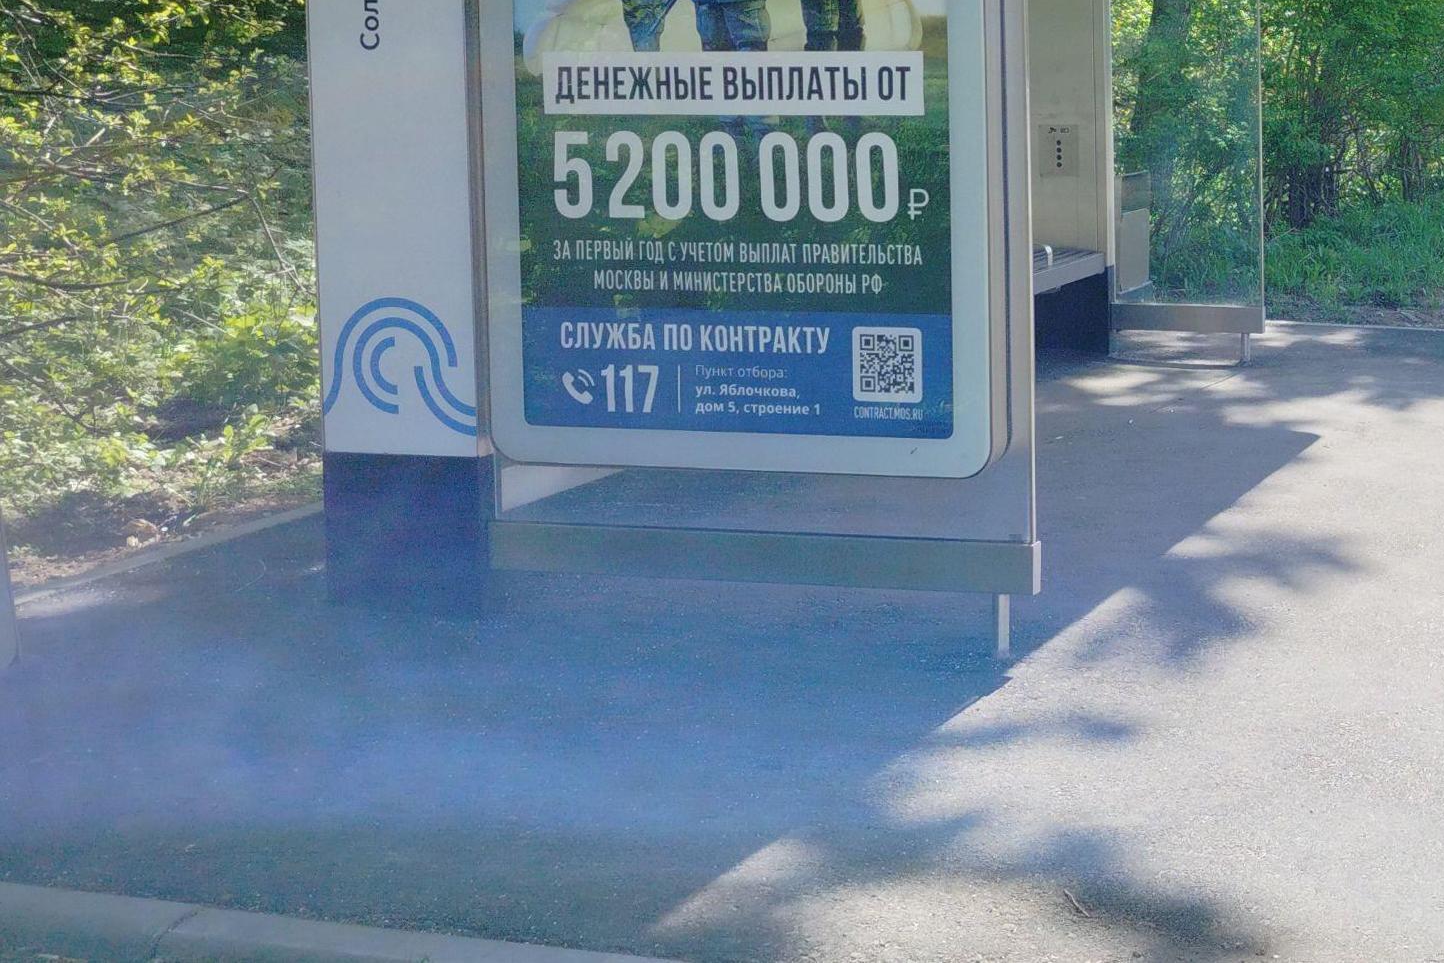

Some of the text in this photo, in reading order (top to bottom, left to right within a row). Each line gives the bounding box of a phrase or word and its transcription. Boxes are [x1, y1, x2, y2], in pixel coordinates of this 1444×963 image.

[555, 66, 911, 104] ДЕНЕЖНЫЕ ВЫПЛАТЫ ОТ
[759, 132, 899, 223] 000
[553, 237, 923, 266] ЗА ПЕРВЫЙ ГОД С УЧЕТОМ ВЫПЛАТ ПРАВИТЕЛЬСТВА
[594, 269, 883, 295] МОСКВЫ И МИНИСТЕРСТВА ОБОРОНЫ РФ
[560, 321, 830, 354] СЛУЖБА ПО КОНТРАКТУ
[695, 364, 788, 380] Пункт отбора:
[600, 364, 660, 414] 117
[695, 384, 800, 399] ул. Яблочкова,
[695, 401, 821, 417] дом 5, строение 1
[853, 405, 924, 421] CONTRACT.MOS.RU
